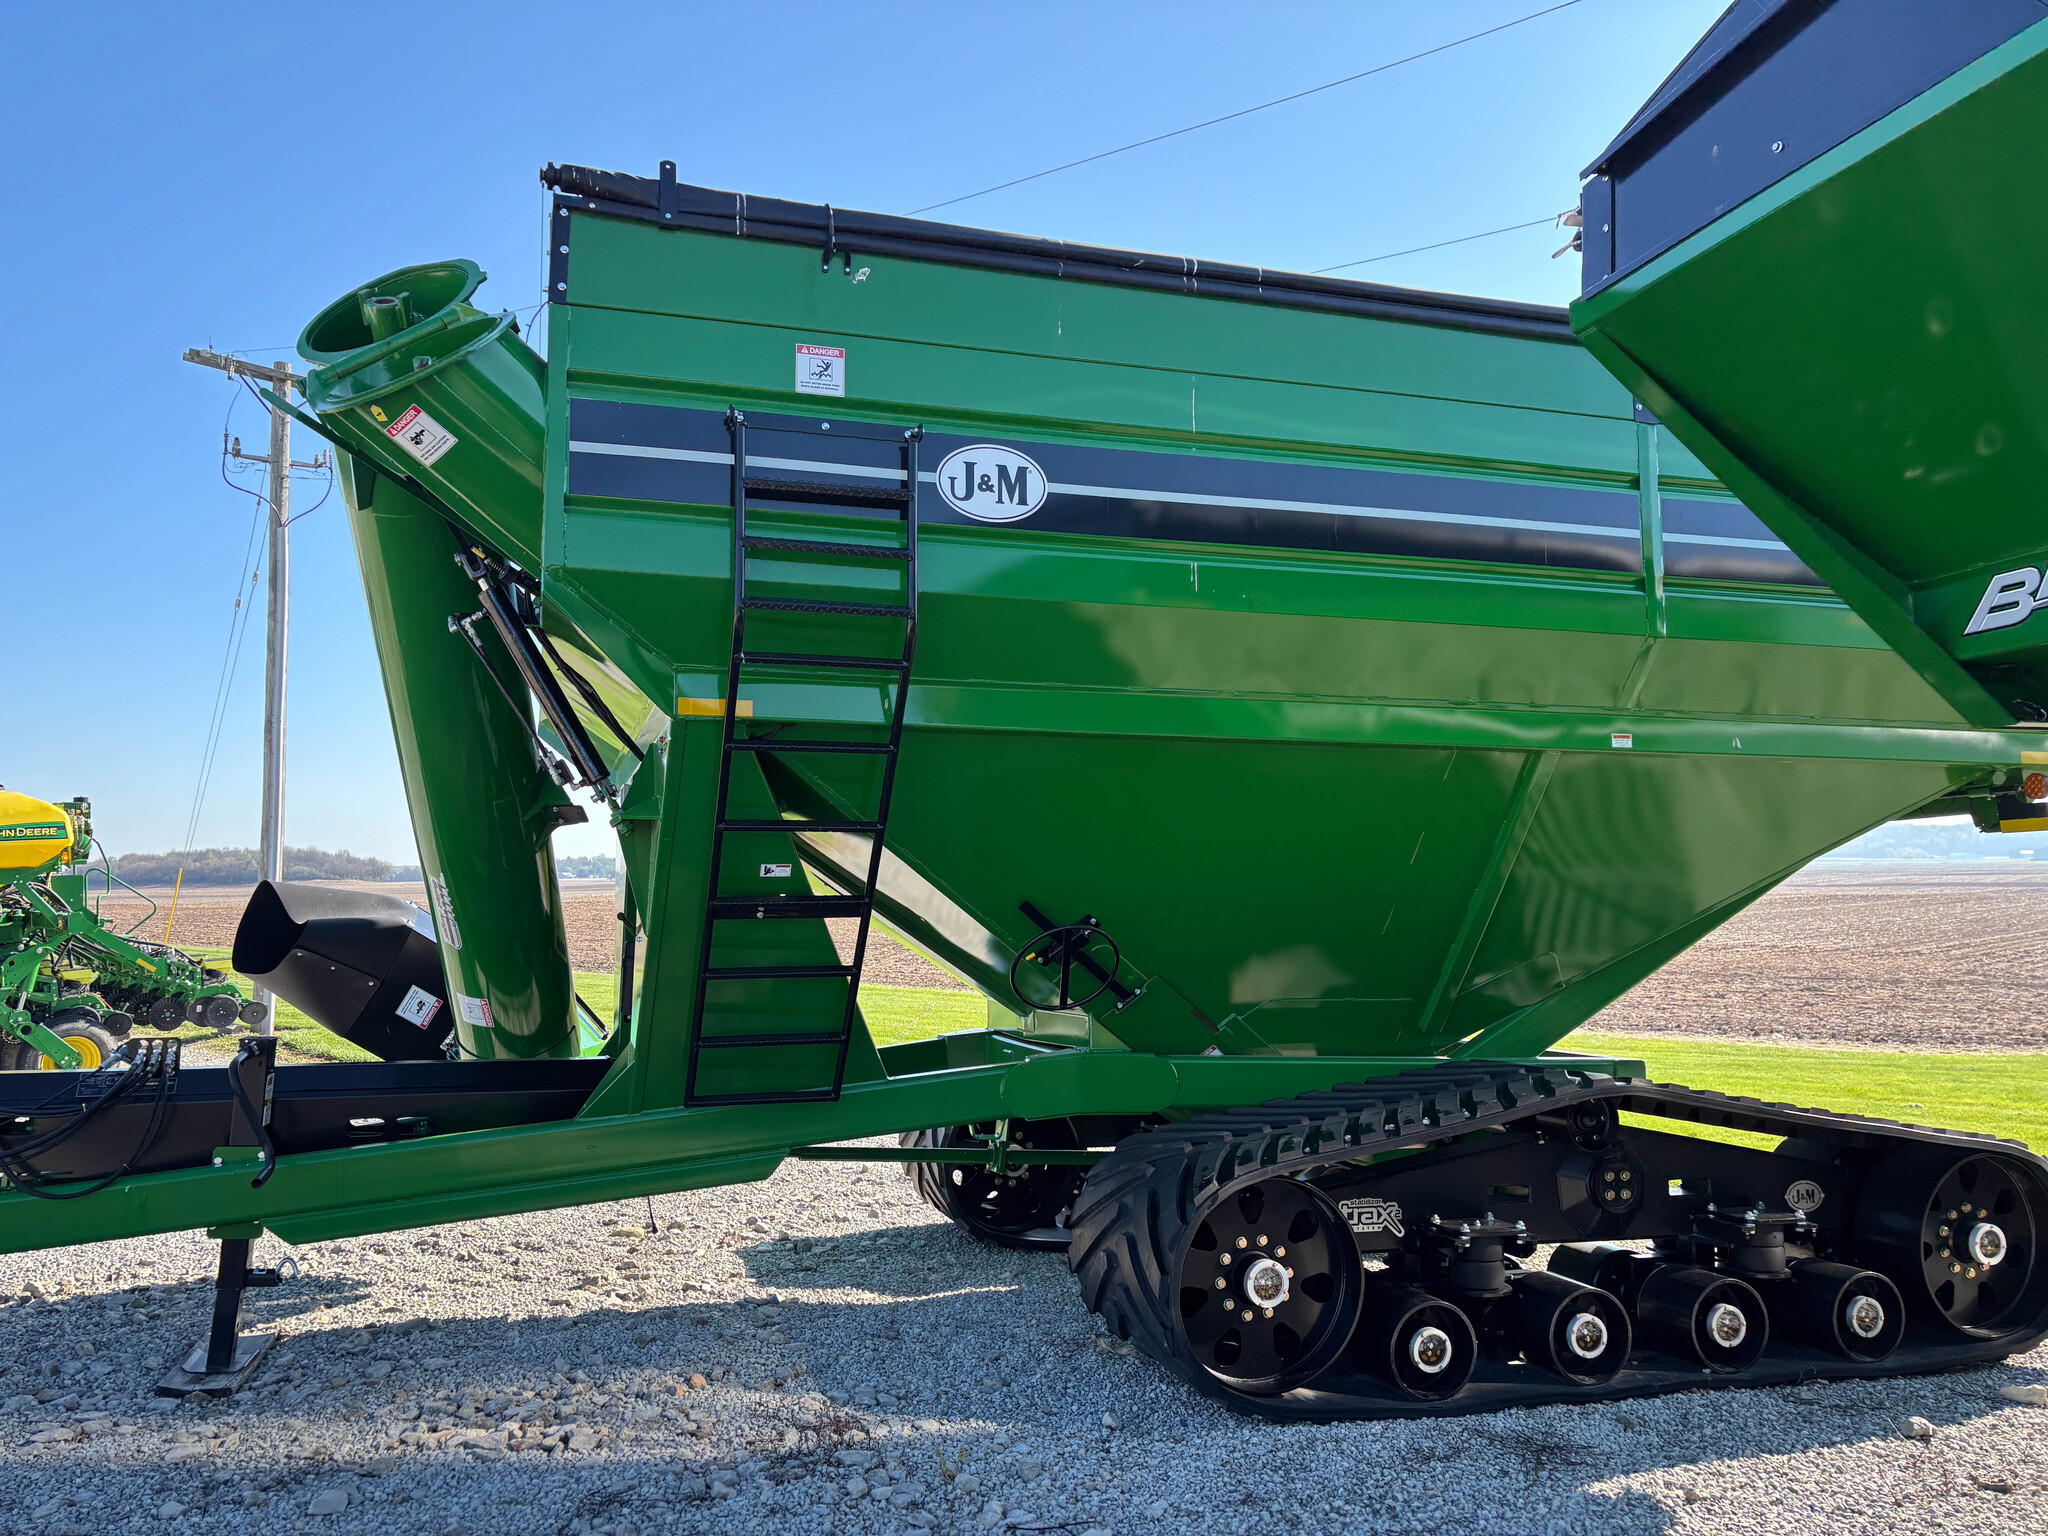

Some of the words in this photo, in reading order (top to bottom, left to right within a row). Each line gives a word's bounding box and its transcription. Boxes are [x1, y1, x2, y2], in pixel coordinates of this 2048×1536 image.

[809, 347, 840, 357] DANGER
[394, 409, 418, 431] DANGER
[16, 828, 58, 837] DEERE
[423, 1007, 436, 1026] DANGER
[1791, 1189, 1816, 1204] J&M
